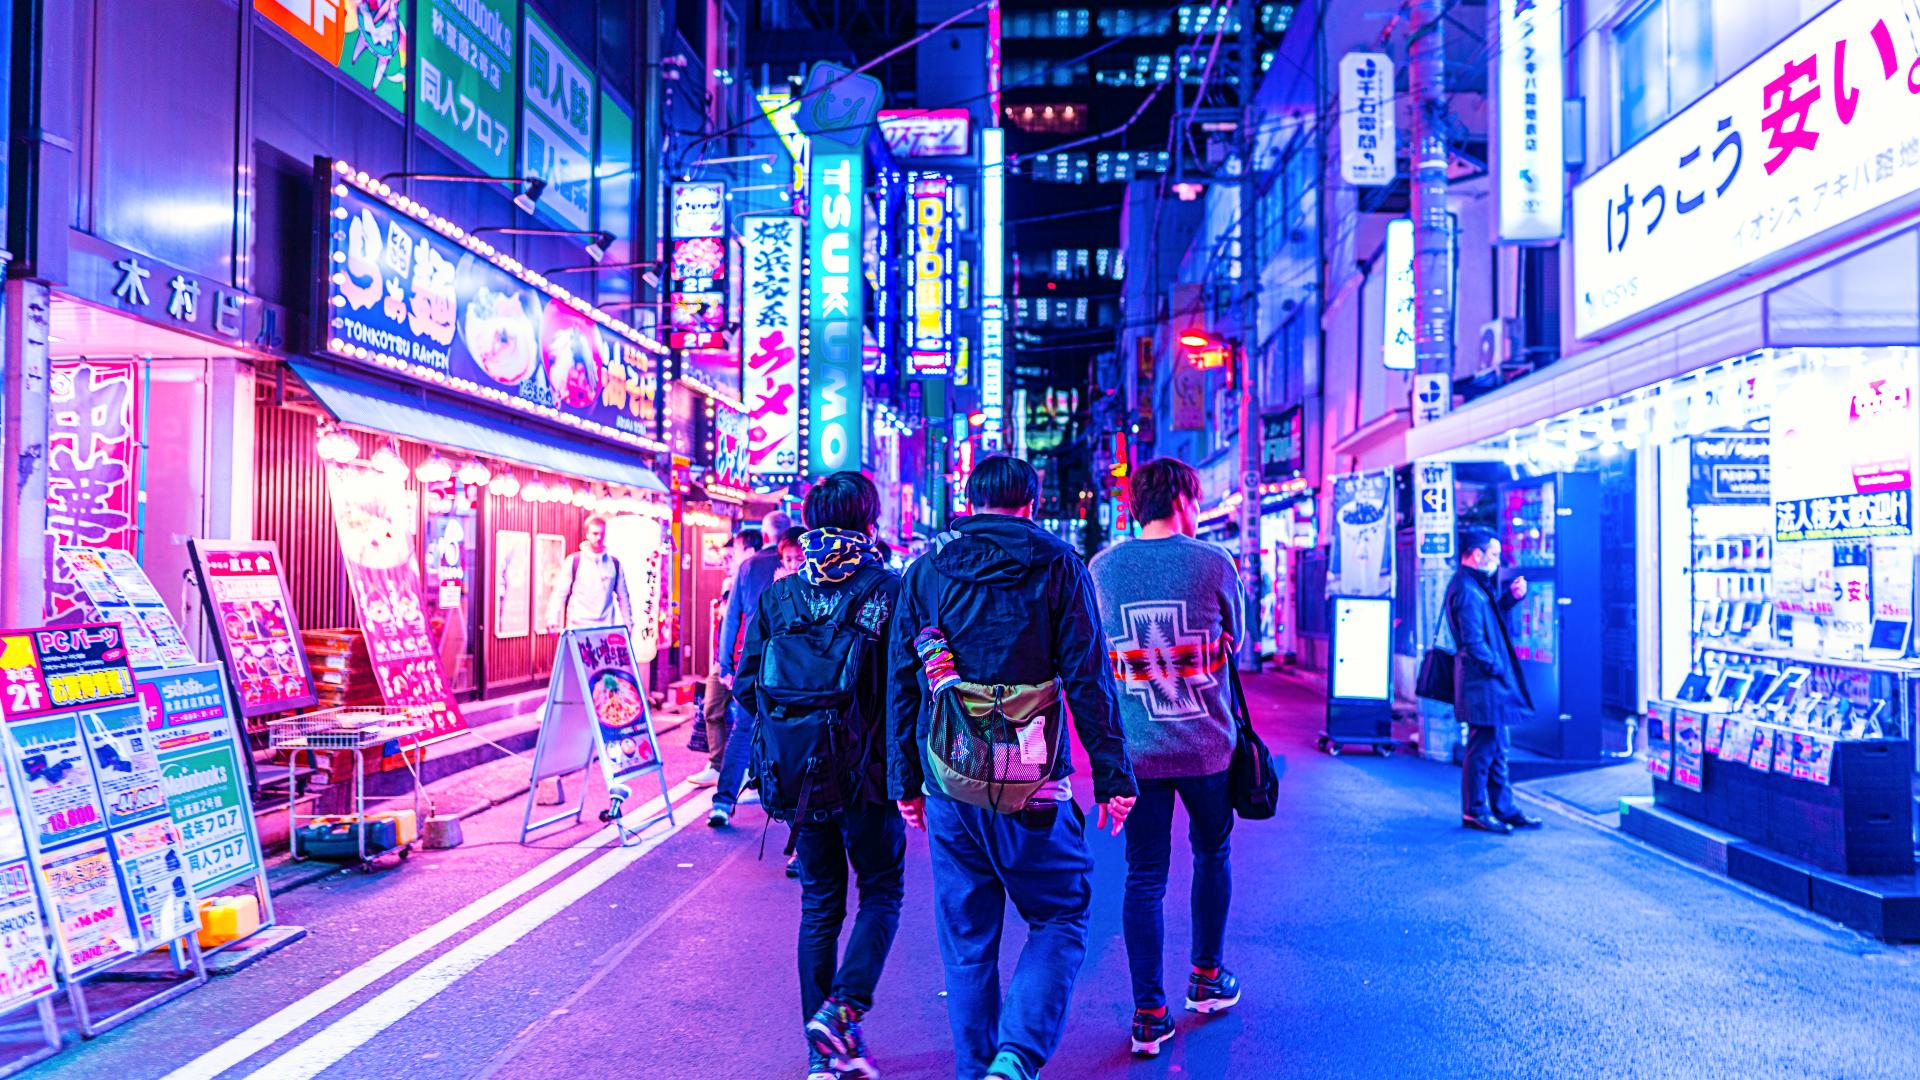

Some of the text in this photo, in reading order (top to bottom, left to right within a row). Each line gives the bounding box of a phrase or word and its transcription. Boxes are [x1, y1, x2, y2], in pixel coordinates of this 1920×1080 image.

[420, 57, 509, 157] 同人フロア
[528, 34, 590, 136] 同人誌
[113, 258, 283, 350] 木村ビル
[683, 278, 713, 292] 2F
[820, 159, 851, 469] TSUKUMO
[344, 317, 450, 370] TONKOTSU RAMEN
[683, 333, 713, 347] 2F
[7, 682, 43, 712] 2F
